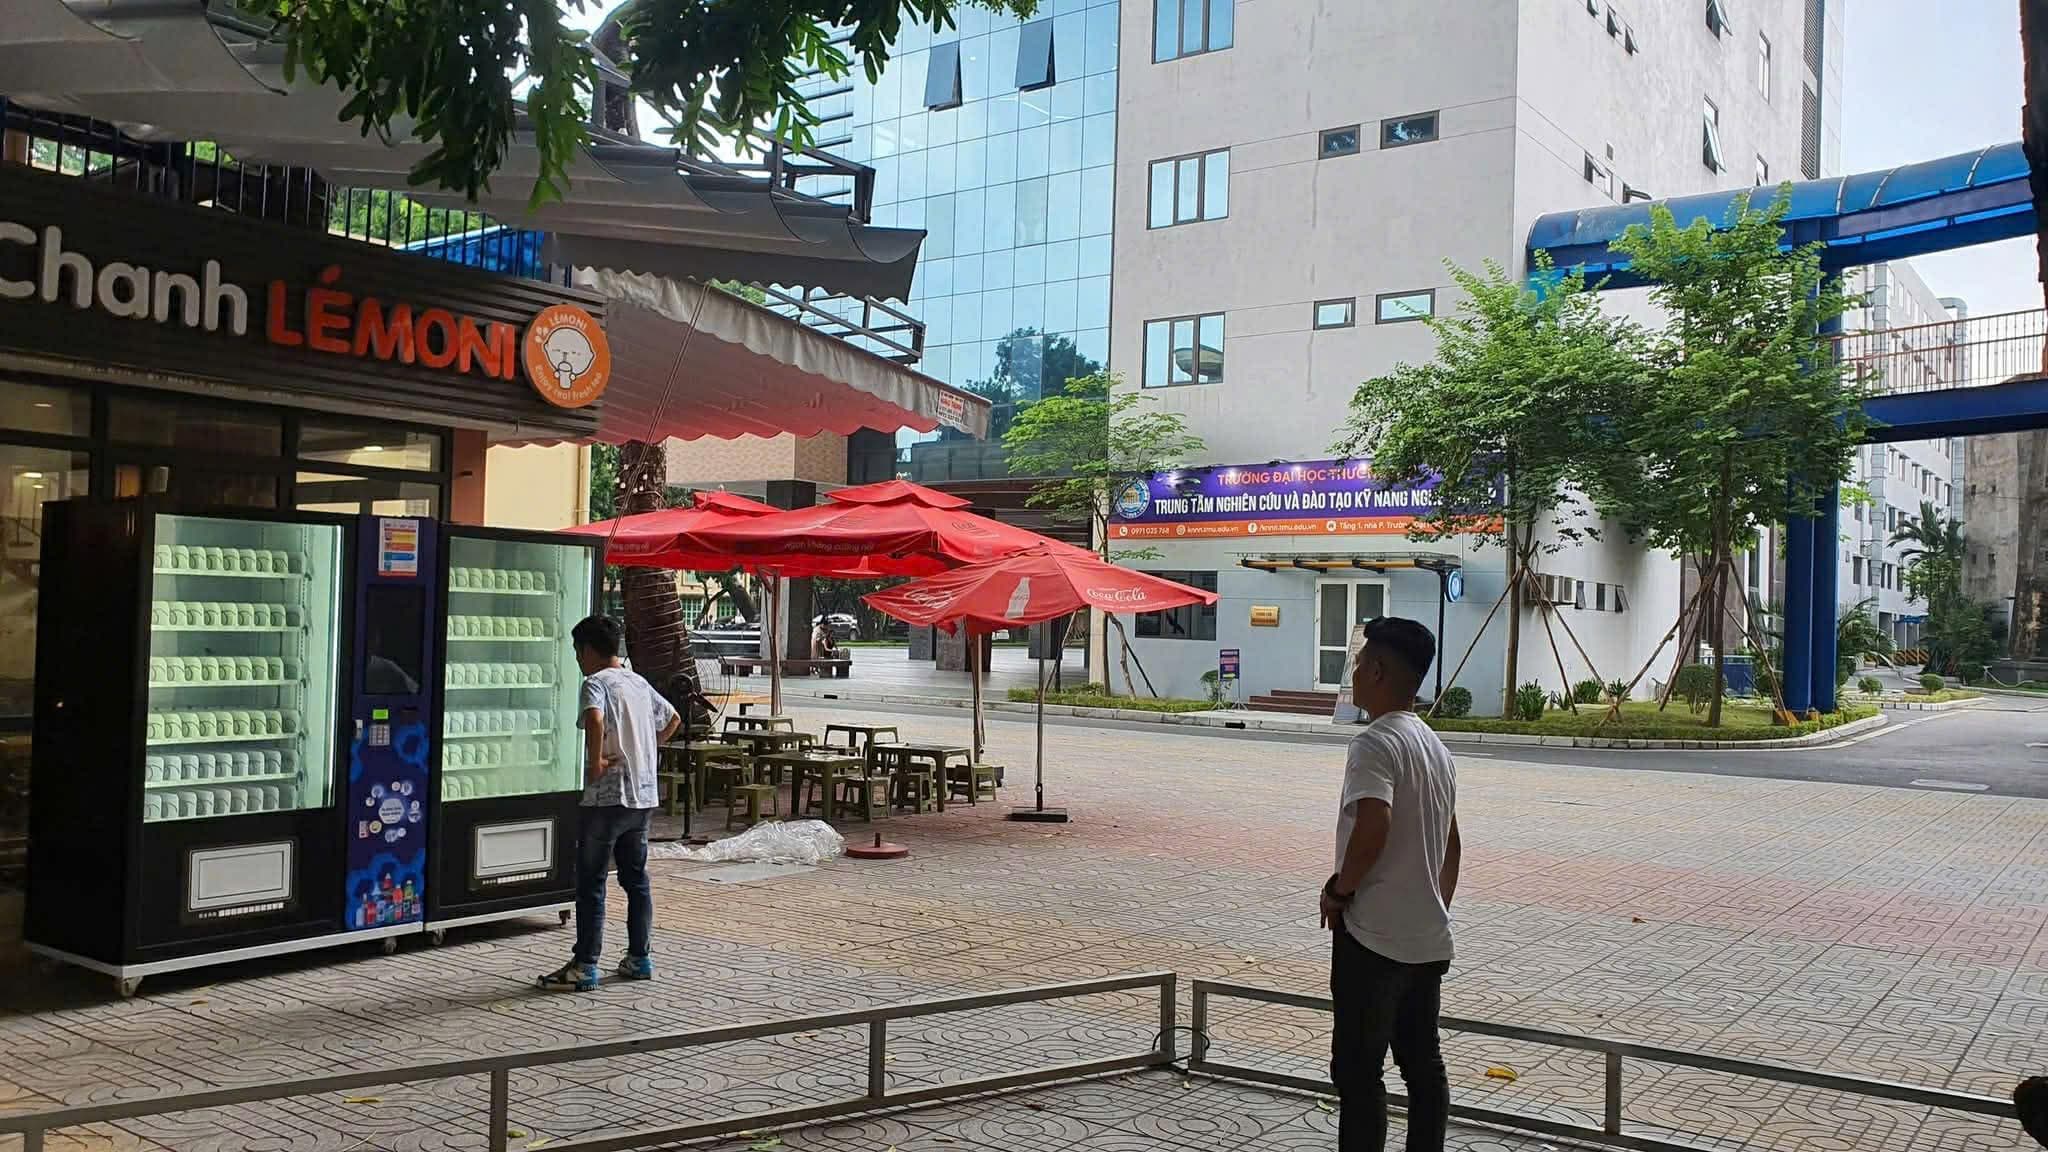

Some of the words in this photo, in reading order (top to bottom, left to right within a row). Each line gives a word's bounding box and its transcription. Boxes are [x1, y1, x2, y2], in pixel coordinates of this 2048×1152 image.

[267, 264, 516, 380] LÉMONI
[548, 312, 588, 330] LÉMONI
[1216, 470, 1270, 485] TRƯỜNG
[1272, 470, 1294, 485] ĐẠI
[1297, 469, 1326, 483] HỌC
[1154, 499, 1188, 515] TRUNG
[1190, 494, 1213, 513] TÂM
[1216, 492, 1255, 513] NGHIÊN
[1259, 491, 1282, 511] CỨU
[1284, 490, 1299, 510] VÀ
[1302, 489, 1325, 509] ĐÀO
[1328, 491, 1351, 511] TẠO
[1354, 488, 1371, 509] KỸ
